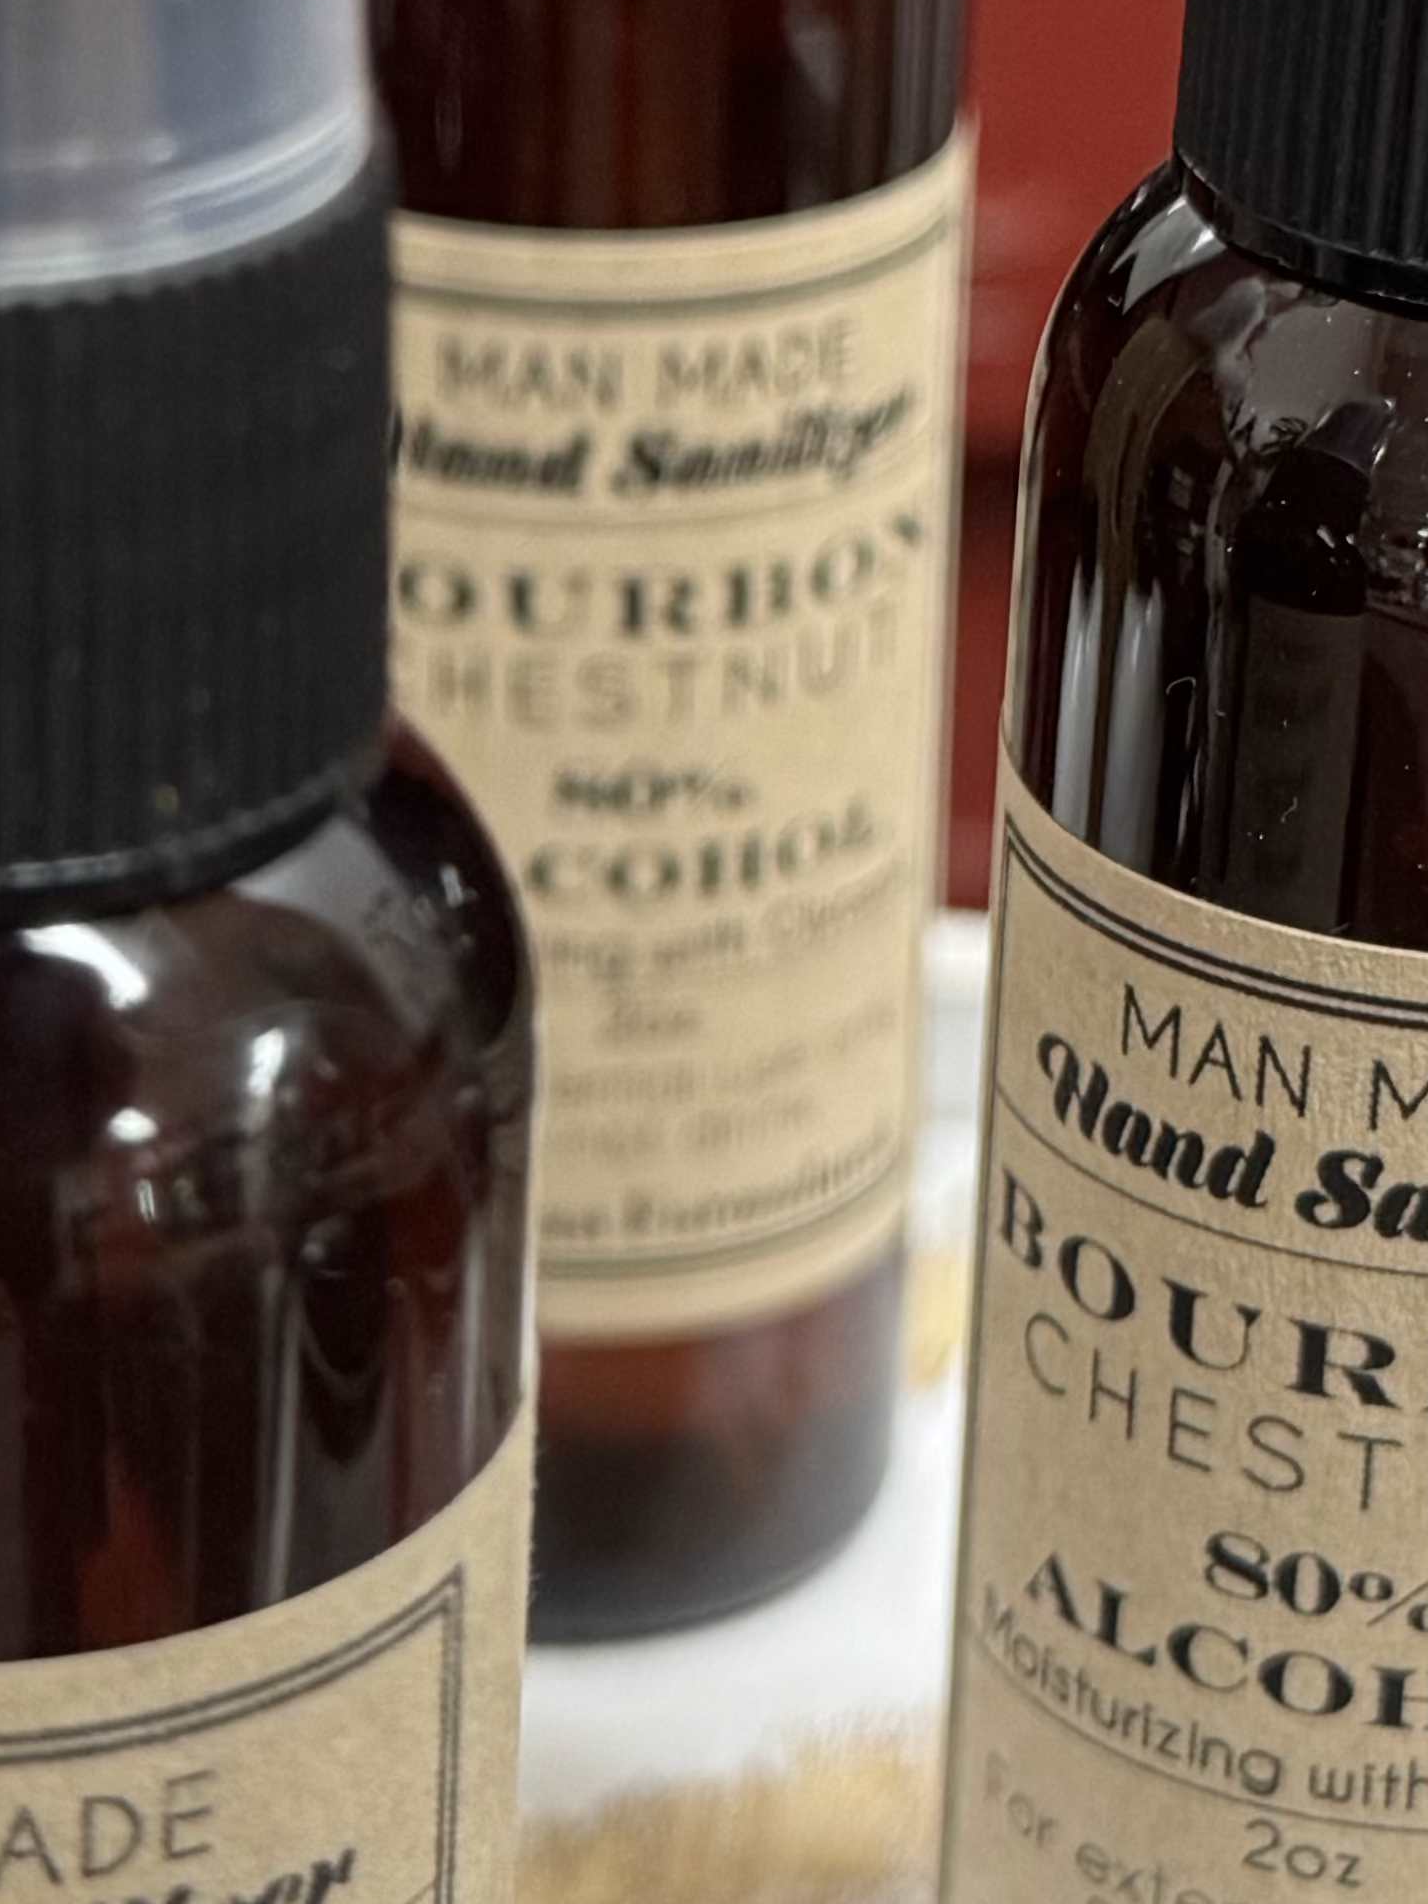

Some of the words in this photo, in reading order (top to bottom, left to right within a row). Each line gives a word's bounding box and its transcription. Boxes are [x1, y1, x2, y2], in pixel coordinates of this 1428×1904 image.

[436, 333, 623, 406] MAN
[657, 319, 857, 404] MADE
[426, 603, 896, 732] HESTNUT
[1121, 983, 1313, 1119] MAN
[1037, 1031, 1276, 1209] Hand
[982, 1580, 1282, 1796] Moisturizing
[983, 1747, 1057, 1848] For
[1242, 1819, 1364, 1891] 2oz
